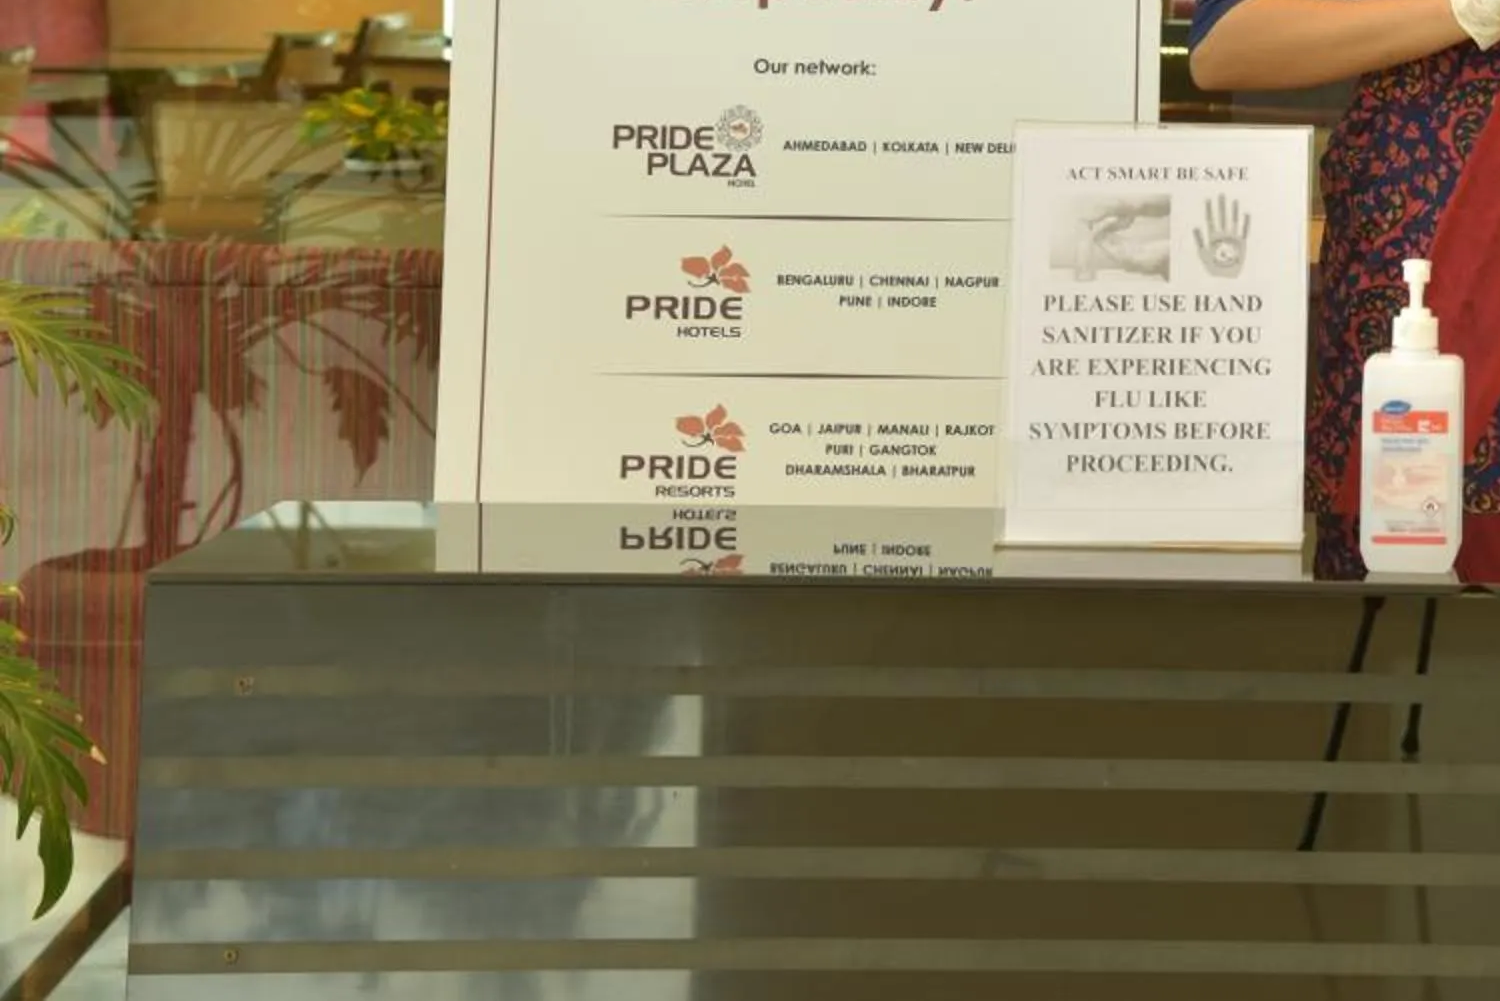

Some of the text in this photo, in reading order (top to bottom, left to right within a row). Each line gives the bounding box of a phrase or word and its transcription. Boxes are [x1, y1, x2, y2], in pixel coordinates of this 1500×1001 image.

[754, 58, 877, 78] Our network:
[612, 124, 715, 150] PRIDE
[783, 140, 866, 152] AHMEDABAD
[883, 142, 939, 152] KOLKATA
[955, 142, 983, 153] NEW
[647, 153, 756, 176] PLAZA
[1067, 166, 1249, 182] ACT SMART BE SAFE
[777, 275, 999, 287] BENGALURU CHENNAI NAGPUR
[625, 295, 743, 320] PRIDE
[839, 296, 937, 307] PUNE INDORE
[1043, 294, 1263, 313] PLEASE USE HAND
[677, 325, 741, 338] HOTELS
[1042, 326, 1262, 344] SANITIZER IF YOU
[1031, 358, 1272, 377] ARE EXPERIENCING
[1095, 390, 1207, 409] FLU LIKE
[769, 423, 993, 436] GOA JAIPUR MANALI RAJKOT
[1029, 422, 1270, 441] SYMPTOMS BEFORE
[826, 444, 936, 456] PURI GANGTOK
[621, 455, 736, 480] PRIDE
[785, 465, 975, 477] DHARAMSHALA BHARATPUR
[1067, 454, 1233, 473] PROCEEDING.
[655, 485, 735, 498] RESORTS
